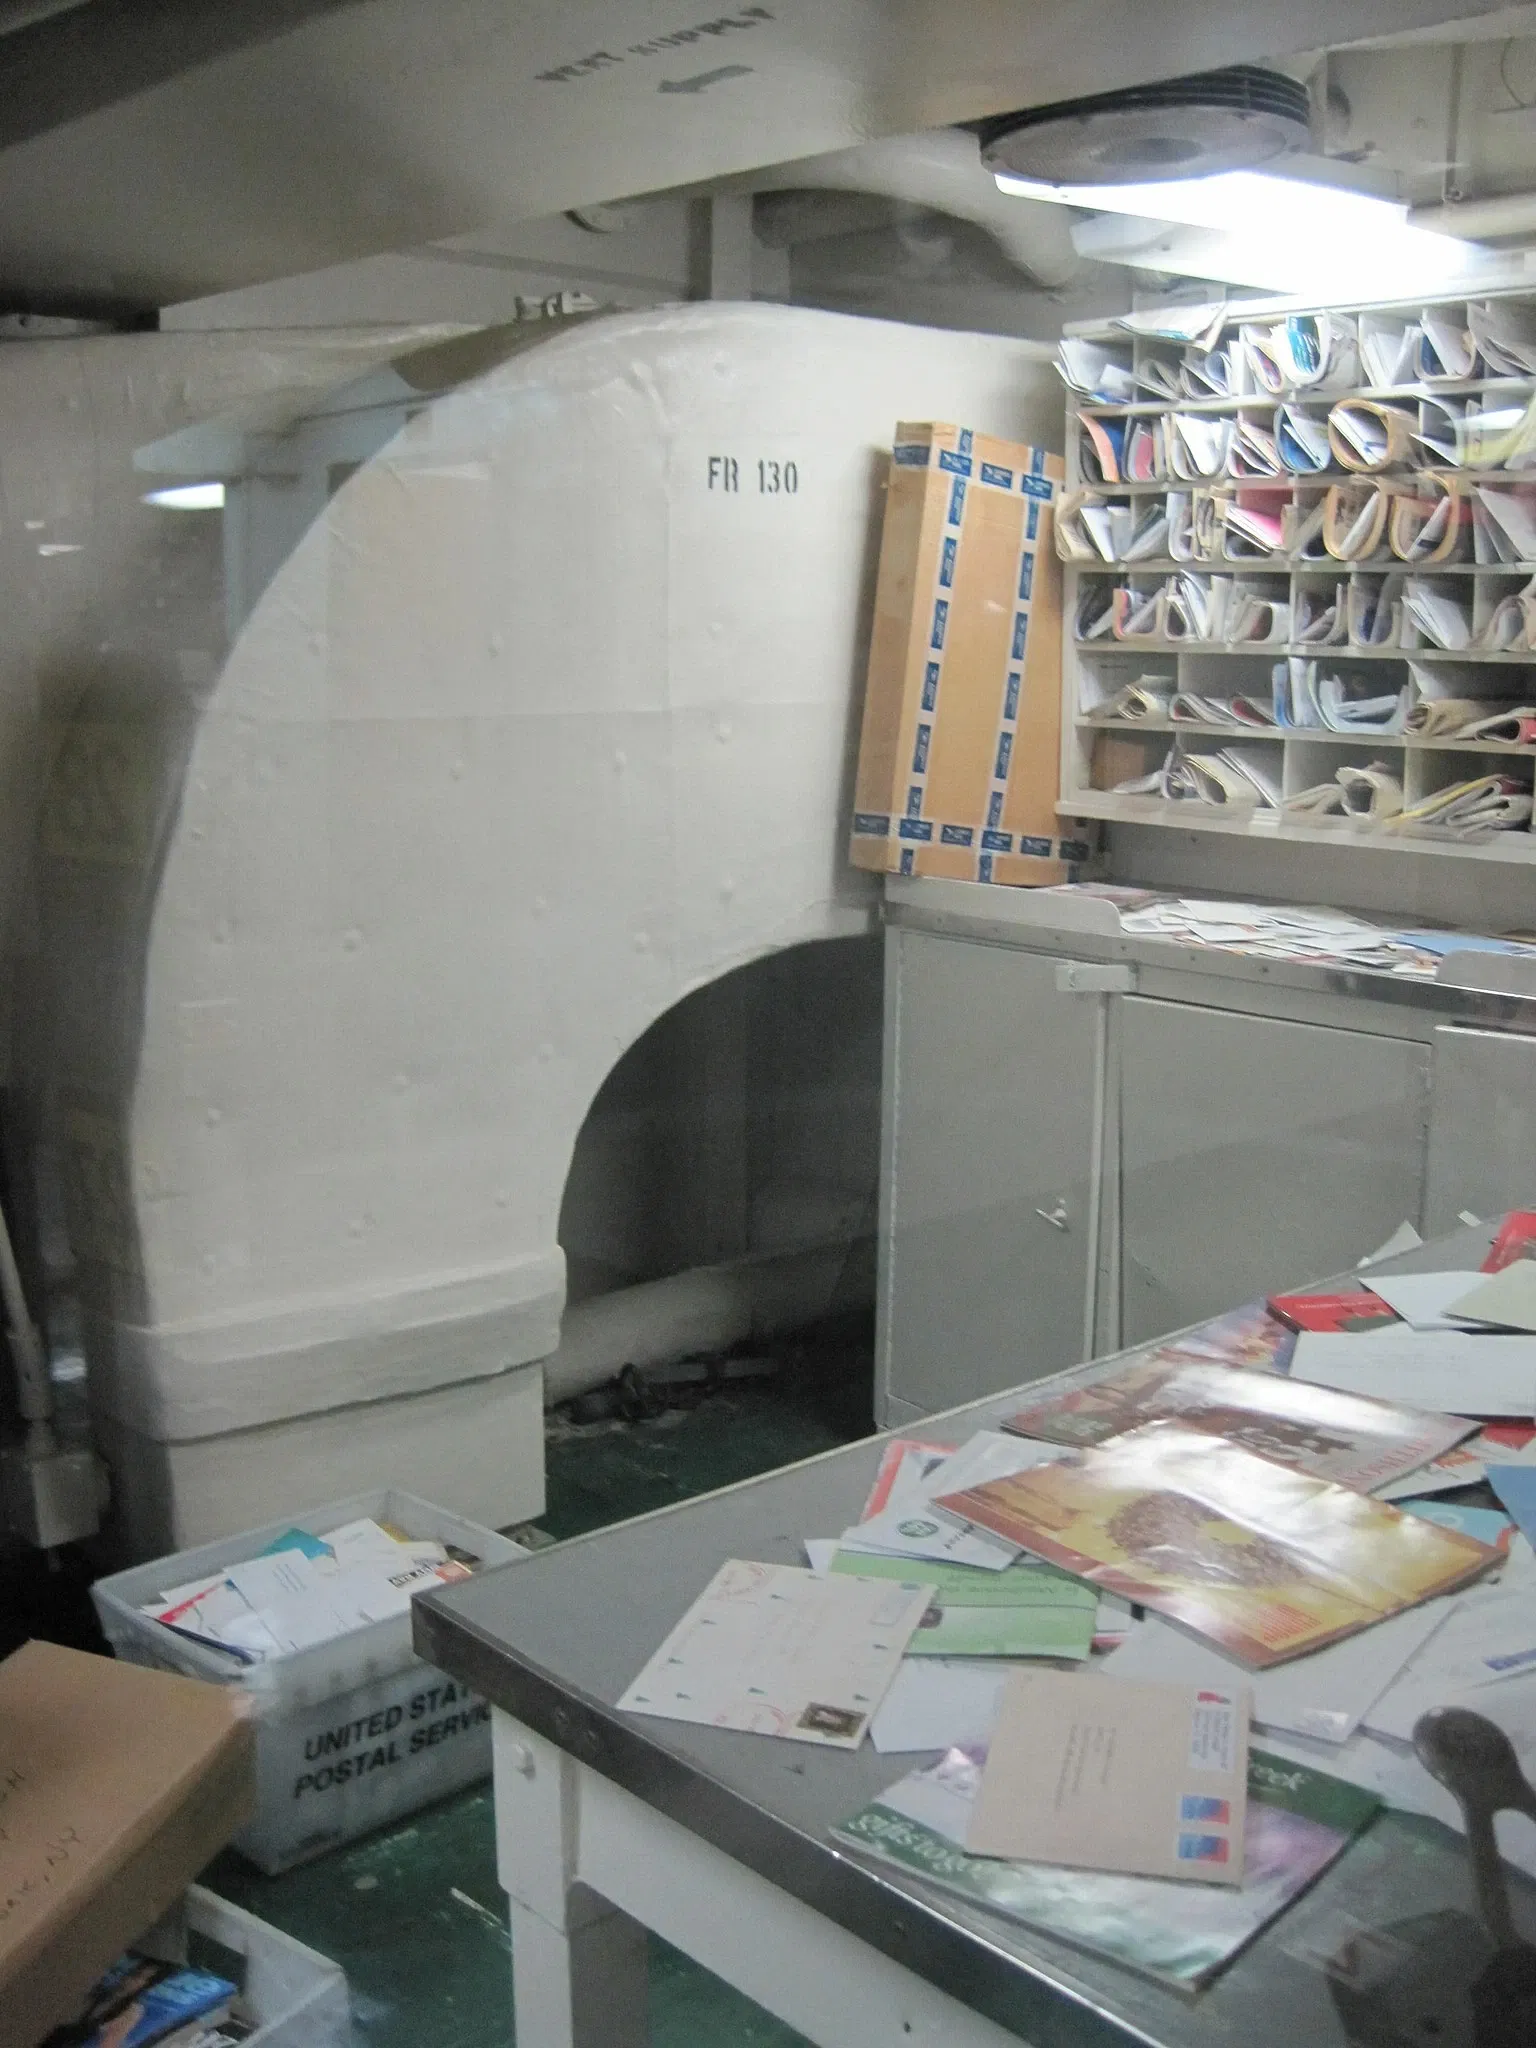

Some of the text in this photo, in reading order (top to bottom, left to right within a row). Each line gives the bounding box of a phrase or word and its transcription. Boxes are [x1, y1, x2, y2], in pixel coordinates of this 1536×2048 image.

[708, 456, 799, 494] FR 130
[303, 1704, 403, 1762] UNITED
[294, 1740, 402, 1799] POSTAL
